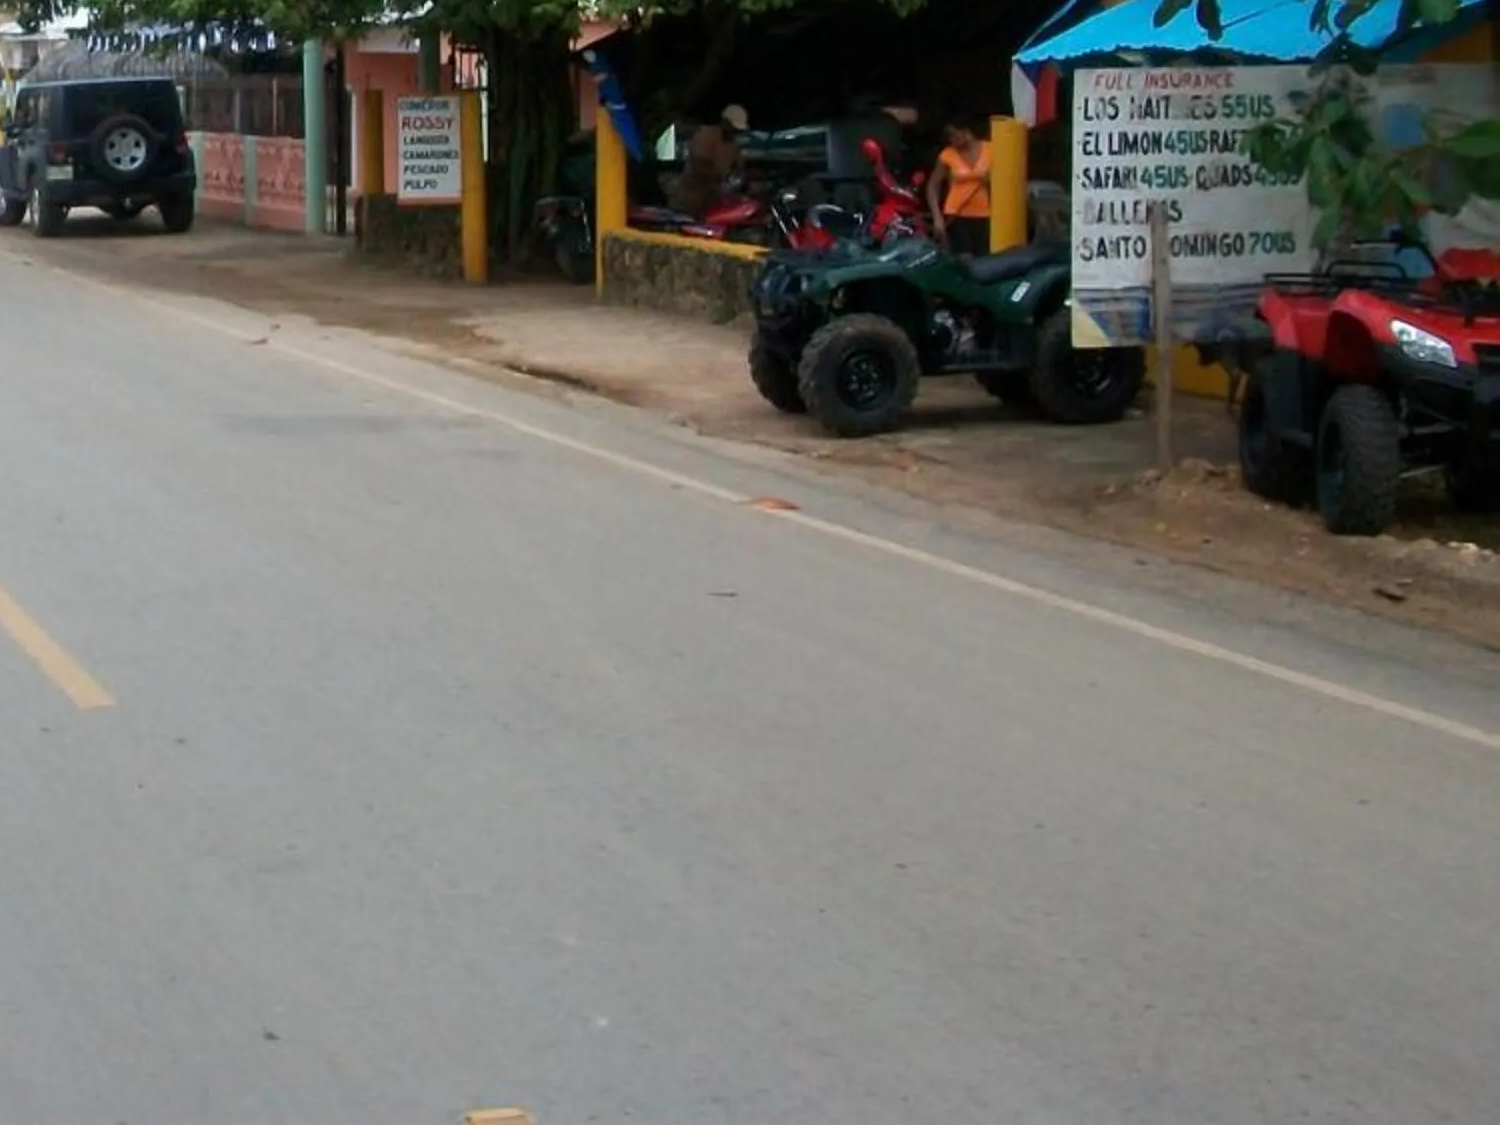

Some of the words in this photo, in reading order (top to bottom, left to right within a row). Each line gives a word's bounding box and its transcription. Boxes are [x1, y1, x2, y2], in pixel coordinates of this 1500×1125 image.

[1094, 72, 1132, 90] FULL
[1145, 71, 1235, 89] INSURANCE
[1083, 96, 1120, 122] LOS
[402, 116, 454, 131] ROSSY
[1082, 131, 1103, 156] EL
[1108, 131, 1162, 156] LIMON
[1081, 166, 1137, 189] SAFARI
[1080, 236, 1147, 262] SANTO
[1169, 232, 1244, 258] OMINGO
